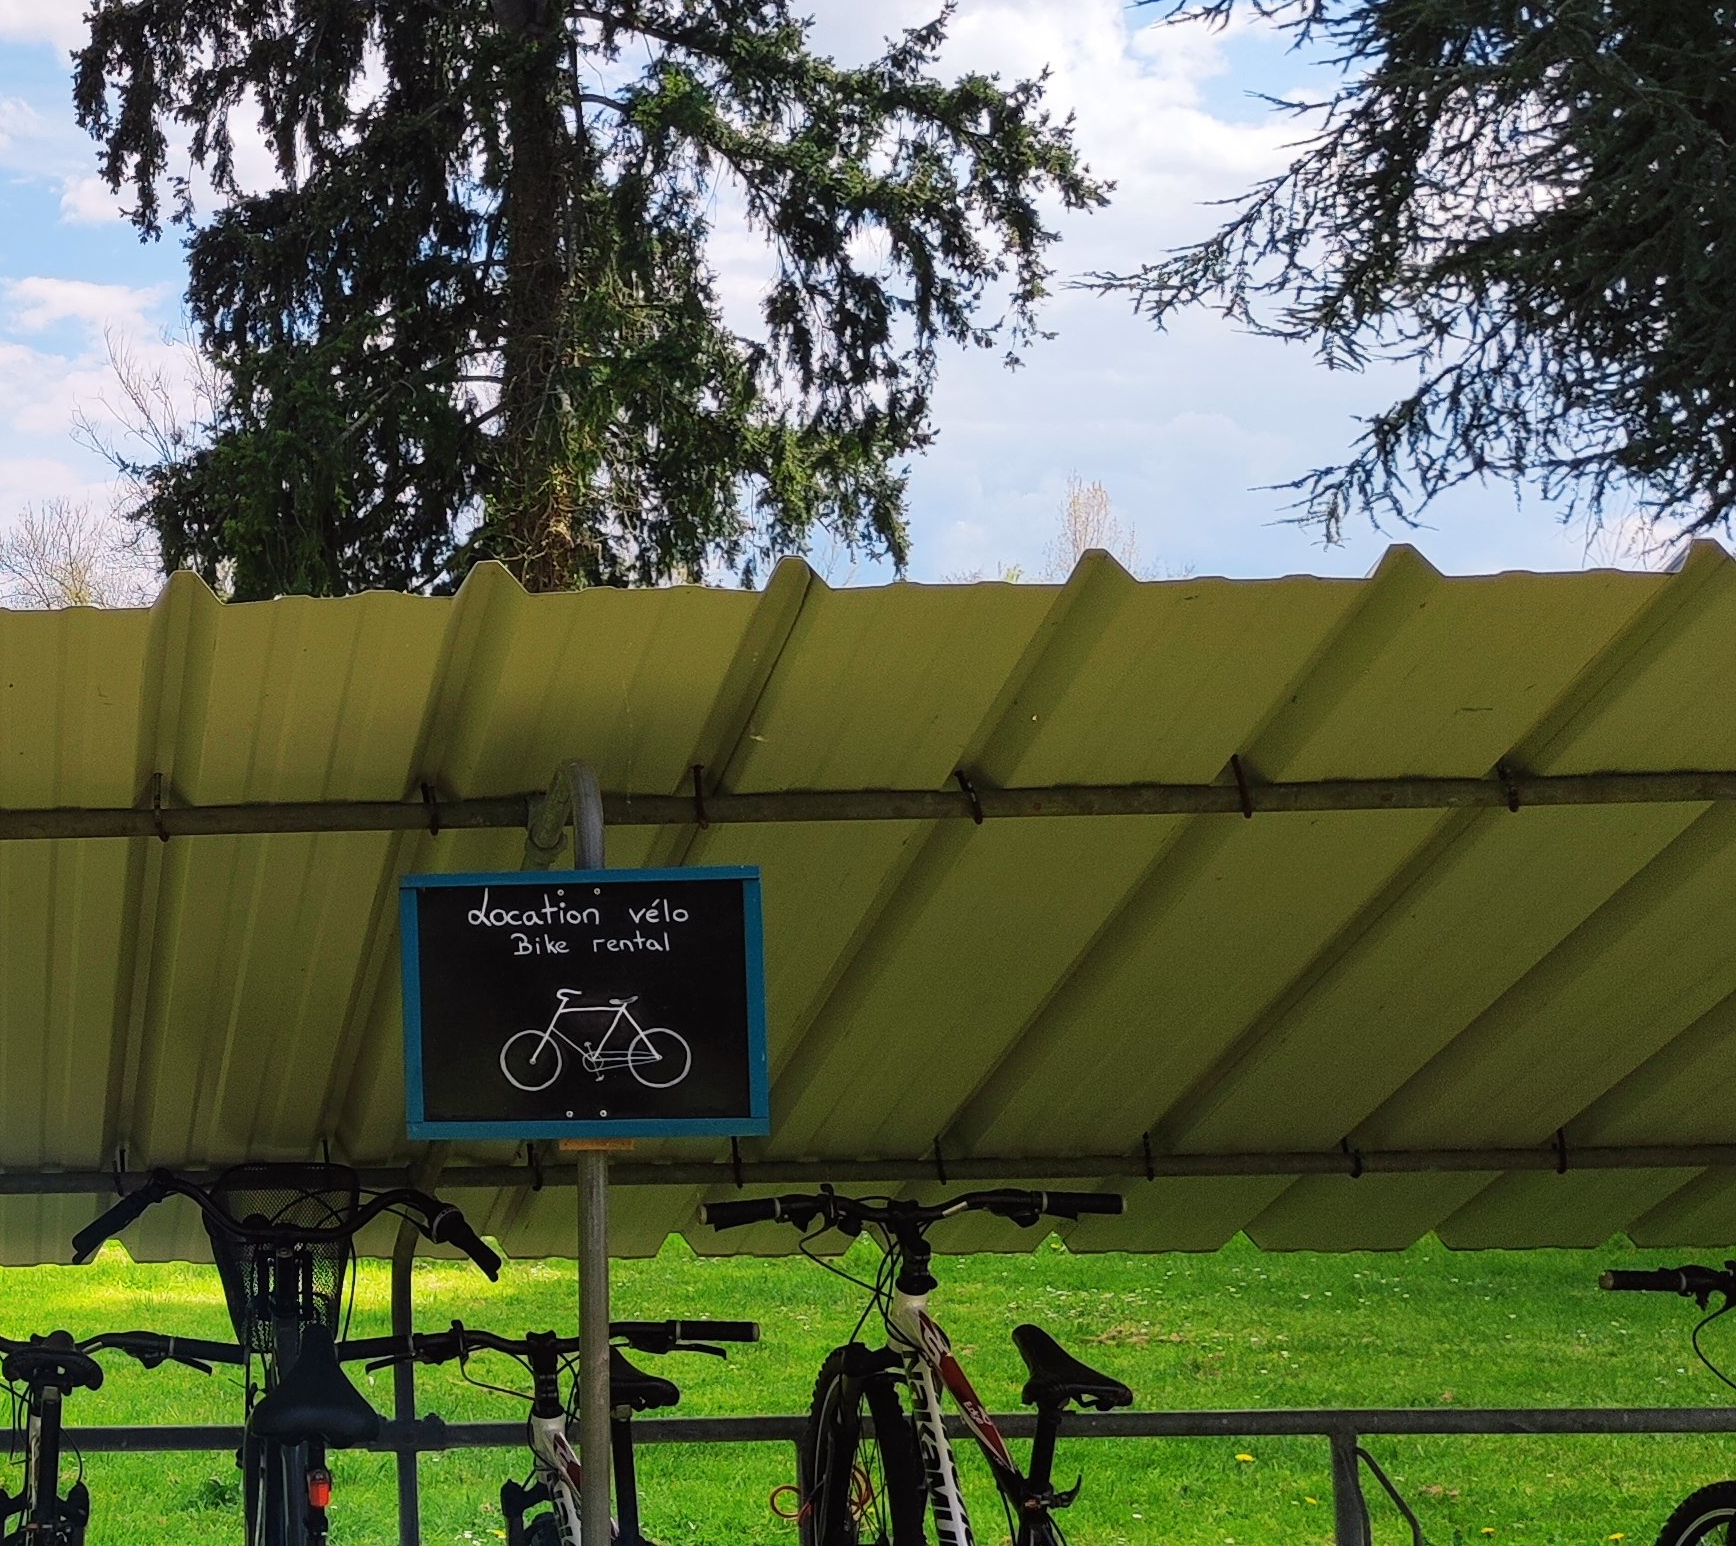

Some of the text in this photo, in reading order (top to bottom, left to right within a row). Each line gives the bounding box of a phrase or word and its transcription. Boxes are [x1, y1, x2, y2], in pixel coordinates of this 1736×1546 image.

[468, 887, 689, 926] Location vélo
[510, 930, 670, 955] Bike rental
